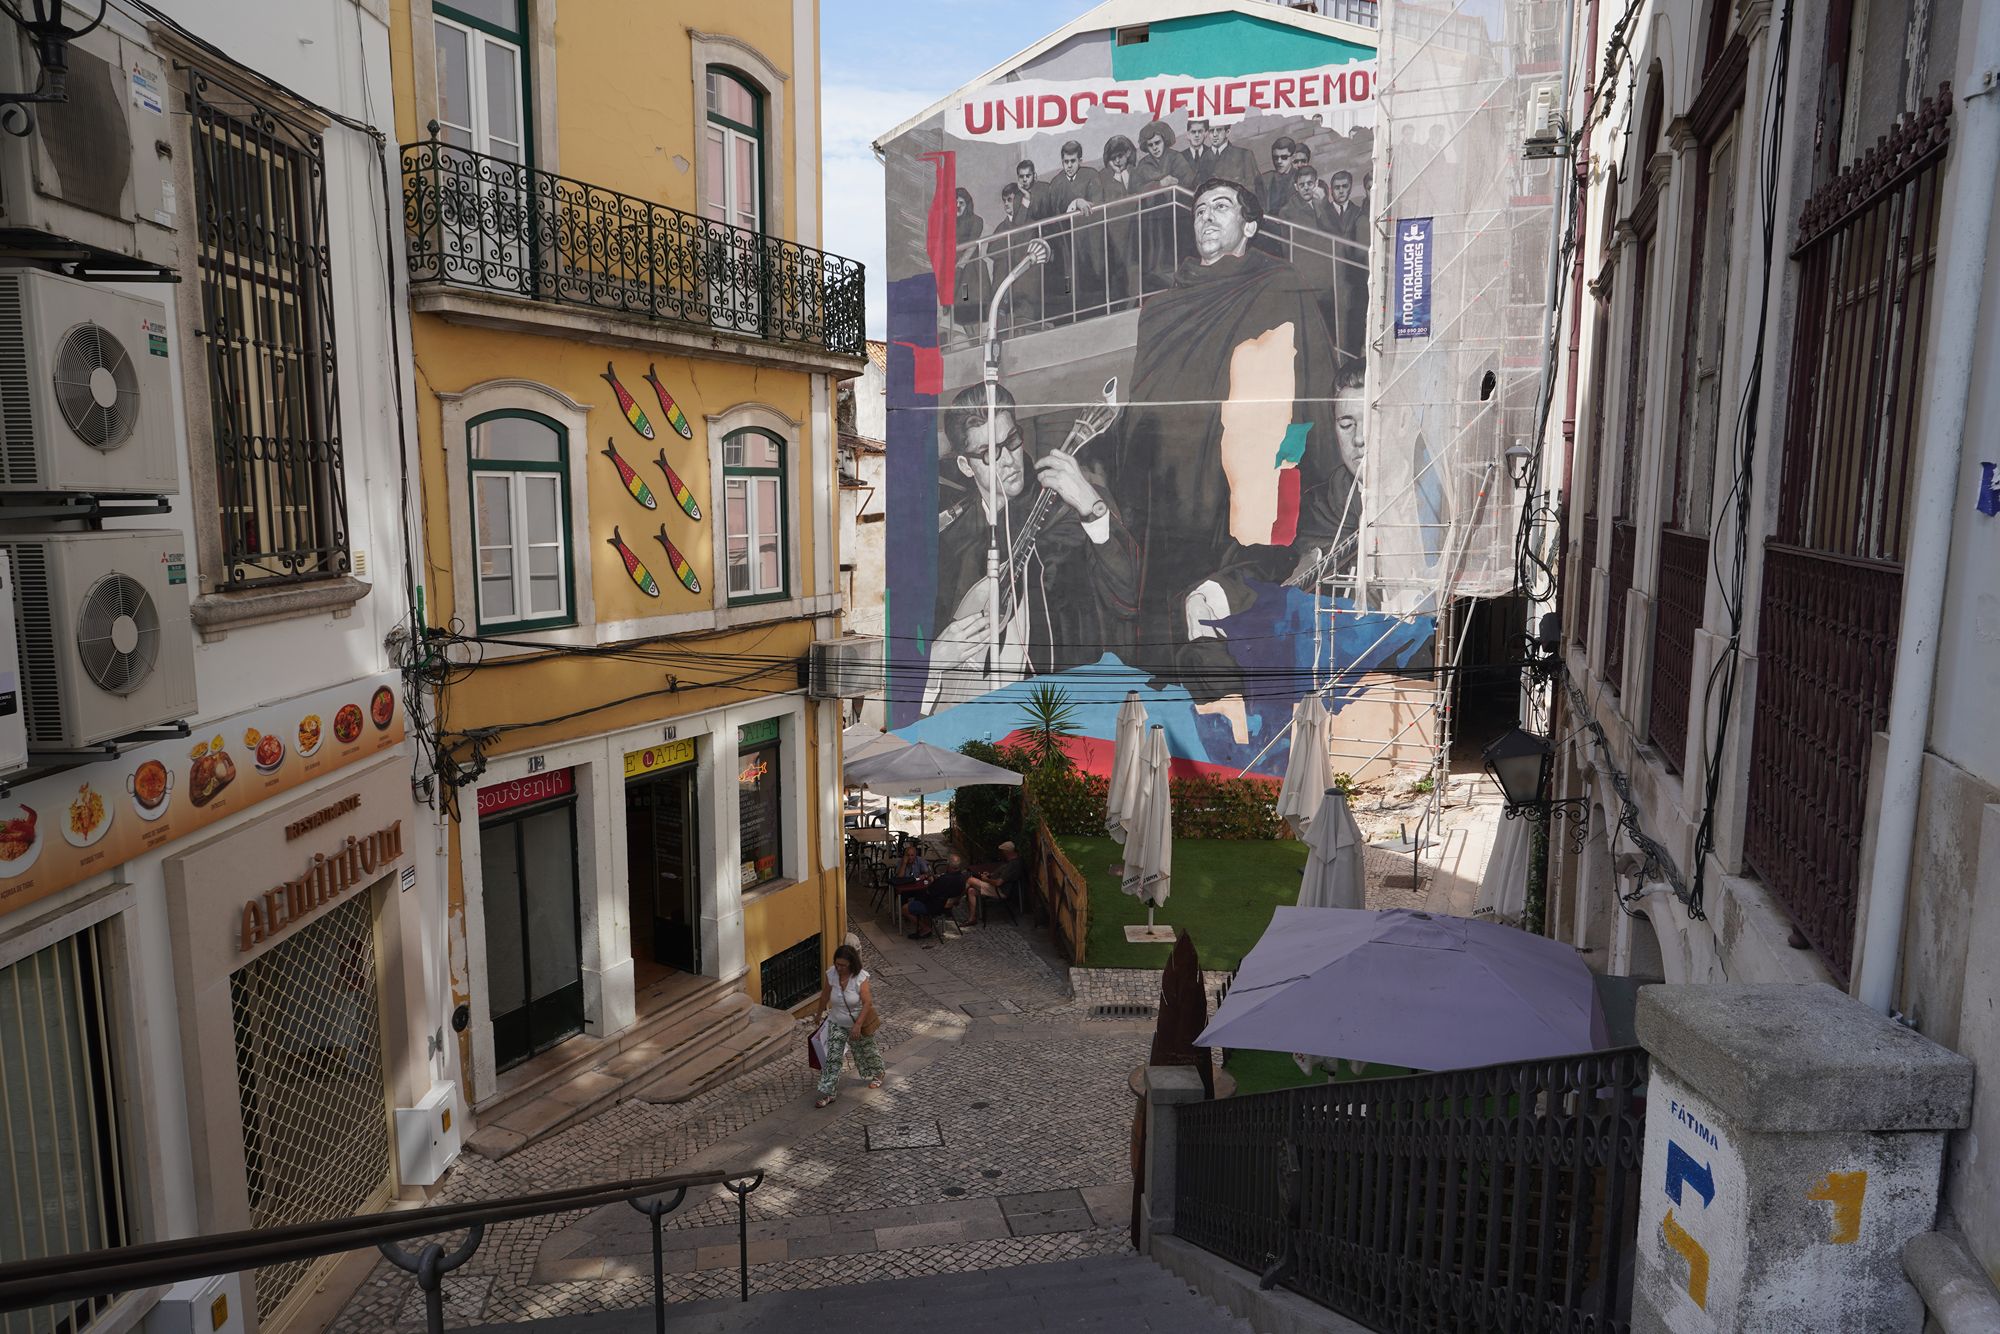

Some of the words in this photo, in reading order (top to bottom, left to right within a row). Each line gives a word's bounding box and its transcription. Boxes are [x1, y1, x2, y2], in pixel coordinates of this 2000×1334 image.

[965, 90, 1129, 135] UNIDOS
[1144, 70, 1377, 122] VENCEREMO
[1402, 243, 1414, 326] MONTALUGA
[1414, 242, 1424, 300] ANDAIMES
[530, 757, 544, 772] 12
[285, 793, 361, 842] RESTAURANTE
[1671, 1100, 1719, 1151] FÁTIMA
